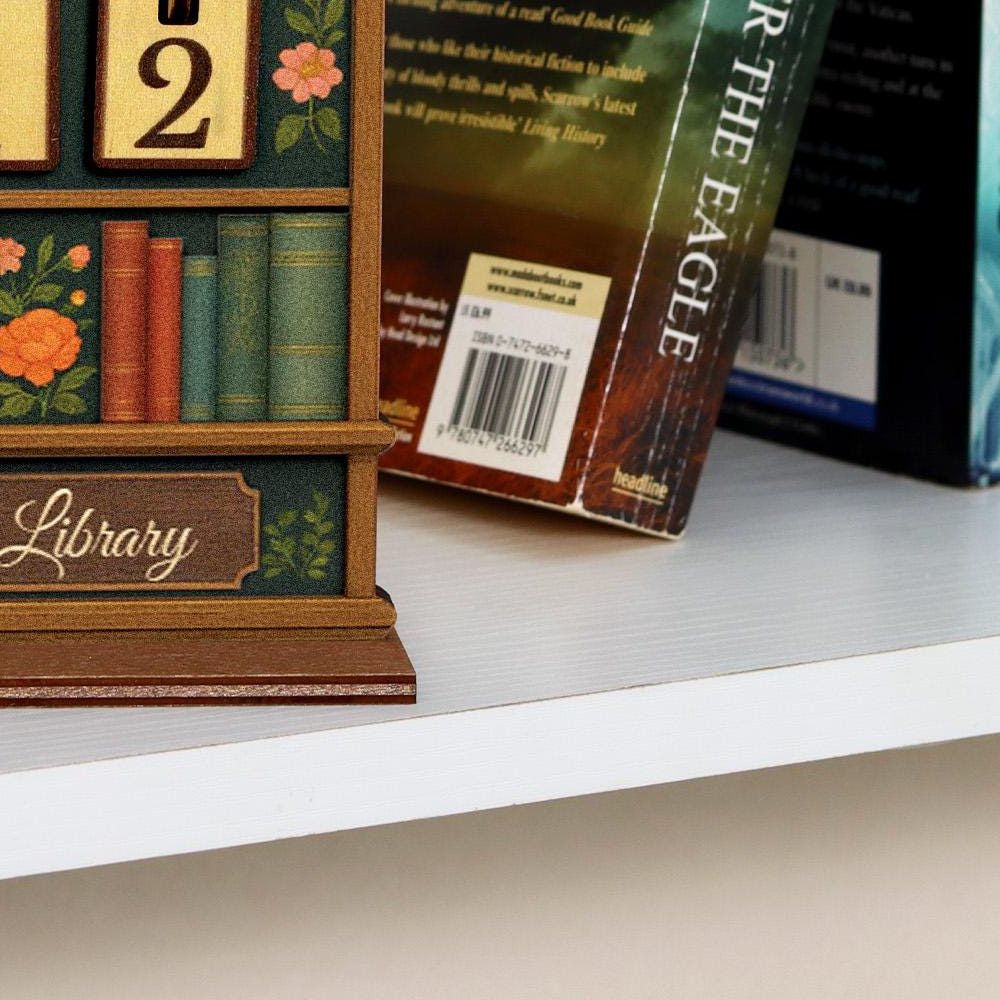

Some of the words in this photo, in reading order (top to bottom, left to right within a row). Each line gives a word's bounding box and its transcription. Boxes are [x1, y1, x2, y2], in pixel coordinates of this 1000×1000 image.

[134, 37, 212, 149] 2
[710, 56, 775, 165] THE
[658, 174, 740, 362] EAGLE
[436, 423, 445, 439] 9
[449, 426, 491, 449] 780747
[496, 435, 541, 458] 266297
[612, 466, 669, 500] headline
